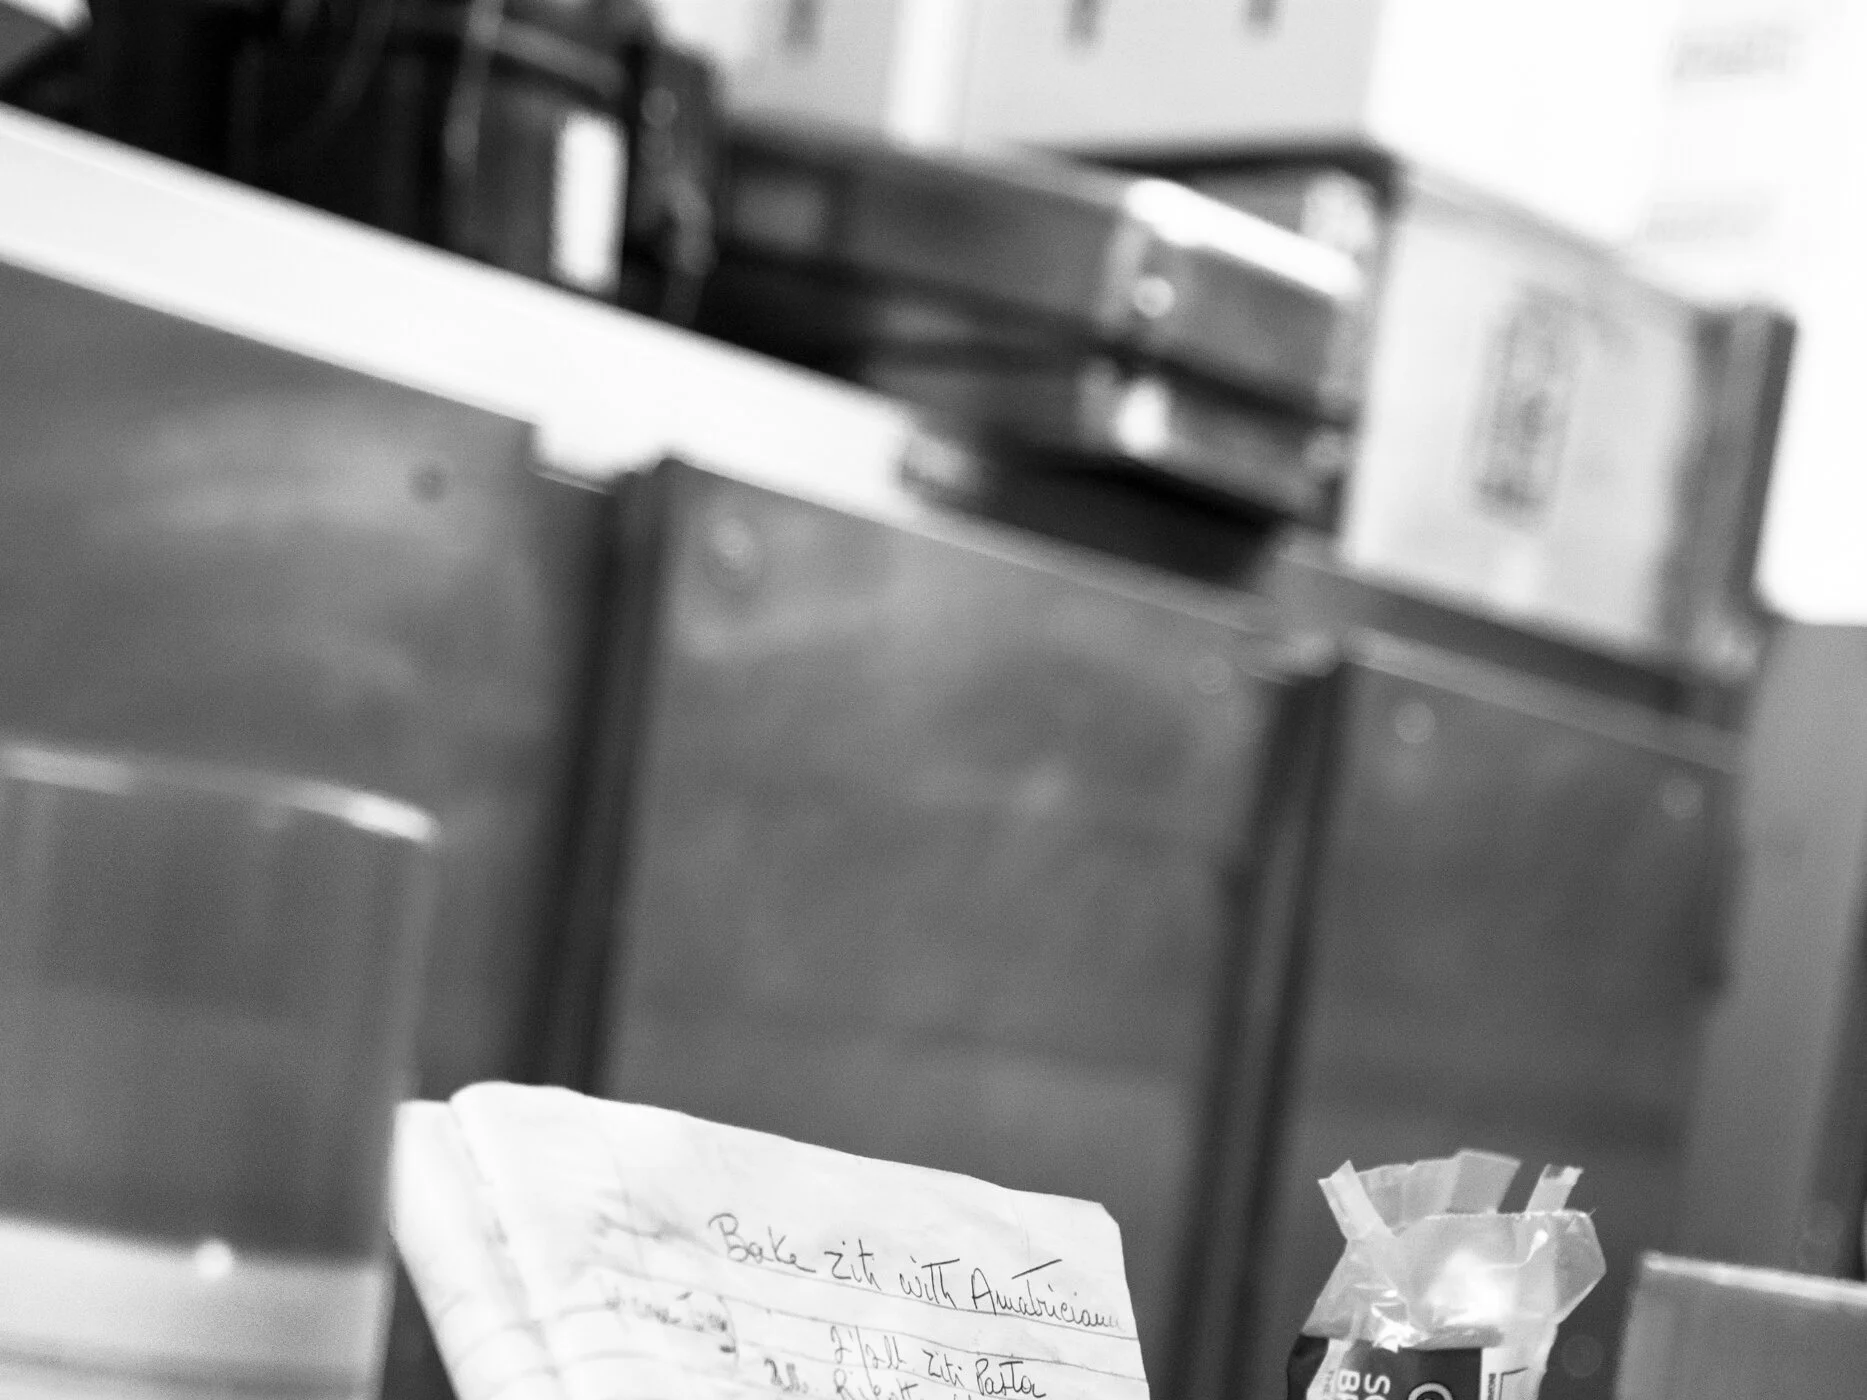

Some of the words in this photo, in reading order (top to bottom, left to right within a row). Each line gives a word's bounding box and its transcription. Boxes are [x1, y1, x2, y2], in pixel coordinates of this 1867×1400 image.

[707, 1212, 816, 1274] Bake
[899, 1255, 960, 1311] with
[921, 1348, 966, 1389] Ziti
[974, 1357, 1047, 1400] Pasta
